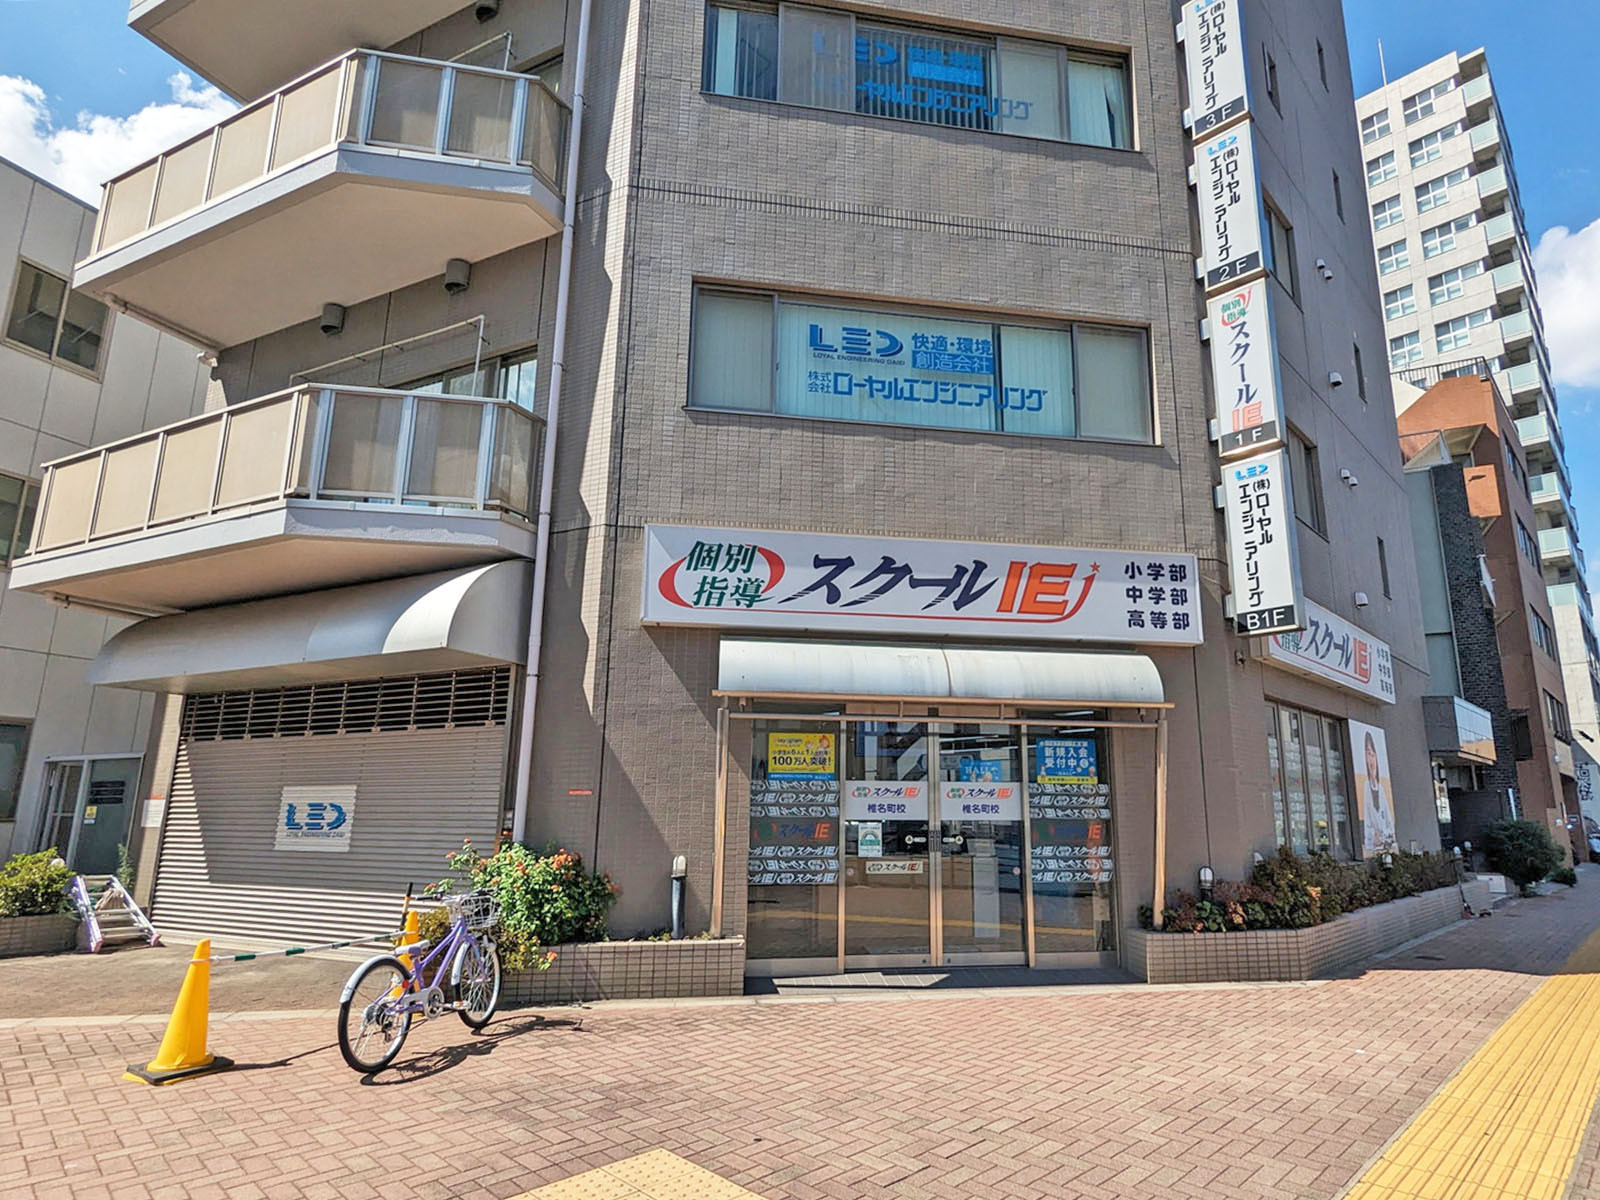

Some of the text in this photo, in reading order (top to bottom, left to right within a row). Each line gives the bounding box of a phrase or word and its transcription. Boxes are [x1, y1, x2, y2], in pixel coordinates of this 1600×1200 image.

[1198, 10, 1219, 111] エンジニアリング
[1206, 103, 1233, 128] 3F
[1210, 155, 1232, 262] エンジニアリング
[1219, 258, 1247, 281] 2F
[809, 324, 904, 357] LED
[911, 332, 993, 356] 快適・環境
[914, 352, 992, 374] 創造会社
[808, 370, 832, 383] 株式
[808, 381, 832, 394] 会社
[833, 372, 1048, 412] ローヤルエンジニアリング
[1235, 428, 1264, 446] 1F
[1253, 478, 1273, 546] (株)ローヤル
[1239, 483, 1264, 608] エンジニアリング
[685, 540, 758, 574] 個別
[1124, 561, 1188, 583] 小学部
[693, 575, 772, 609] 指導
[1125, 585, 1189, 606] 中学部
[1127, 609, 1191, 631] 高等部
[1246, 609, 1286, 630] B1F
[772, 755, 832, 767] 100万人突破!
[1044, 747, 1088, 758] 新規入会
[1045, 757, 1078, 769] 受付中
[285, 802, 347, 831] LED
[867, 803, 907, 814] 椎名町校
[962, 804, 1000, 814] 椎名町校
